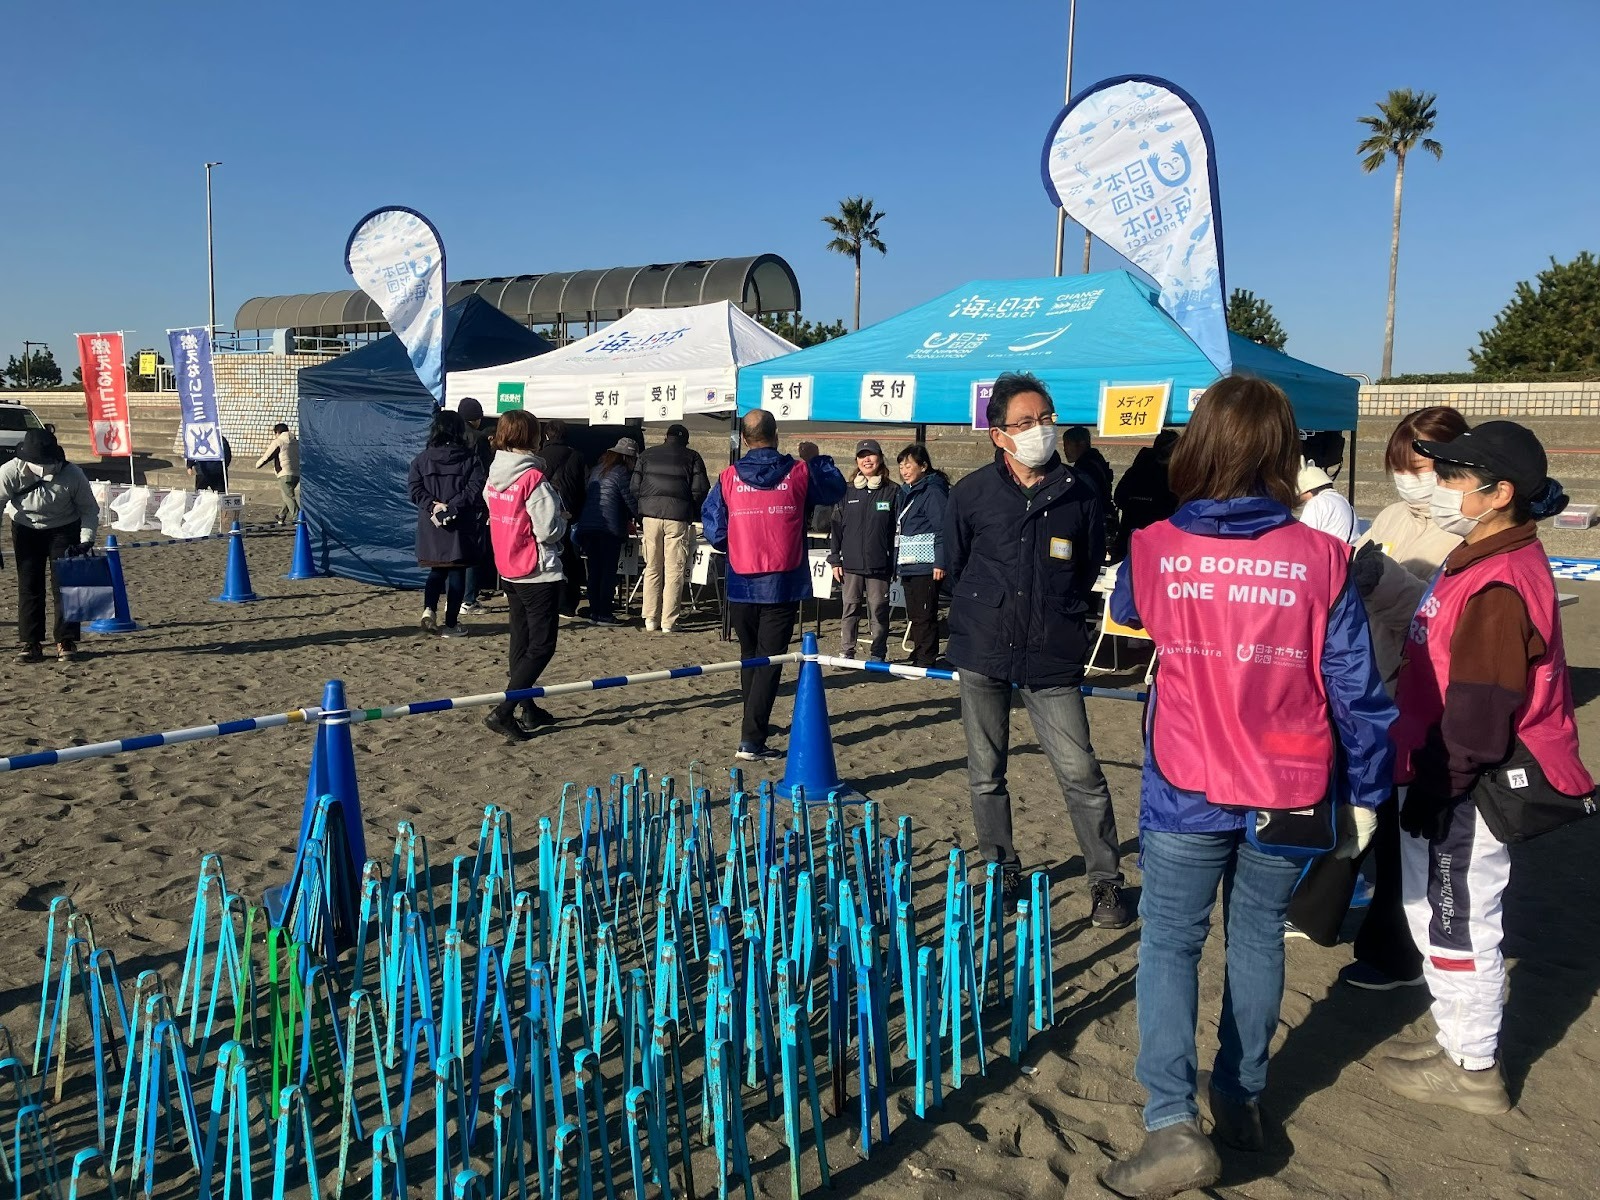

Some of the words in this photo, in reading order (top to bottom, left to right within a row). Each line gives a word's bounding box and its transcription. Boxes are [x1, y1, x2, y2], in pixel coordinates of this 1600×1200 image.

[949, 294, 1044, 318] 海と日本
[651, 384, 677, 402] 受付
[770, 382, 803, 400] 受付
[870, 379, 906, 399] 受付
[594, 390, 620, 407] 受付
[1116, 395, 1154, 409] メディア
[1119, 411, 1148, 426] 受付
[1160, 555, 1192, 574] NO
[1200, 556, 1308, 582] BORDER
[1167, 581, 1215, 600] ONE
[1228, 584, 1297, 607] MIND
